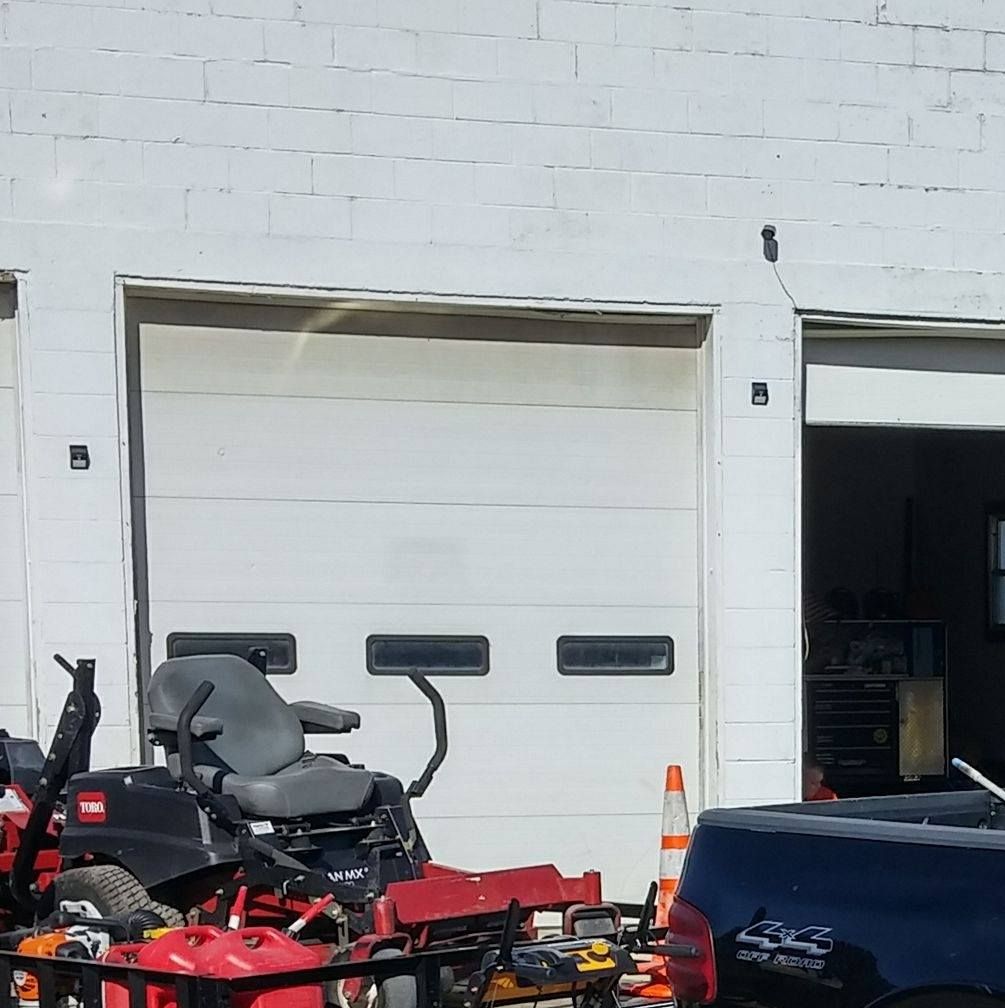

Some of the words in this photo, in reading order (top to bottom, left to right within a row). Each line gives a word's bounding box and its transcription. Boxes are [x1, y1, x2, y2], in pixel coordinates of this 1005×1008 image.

[80, 801, 105, 813] TORO
[736, 950, 771, 962] OFF
[773, 954, 825, 969] ROAD
